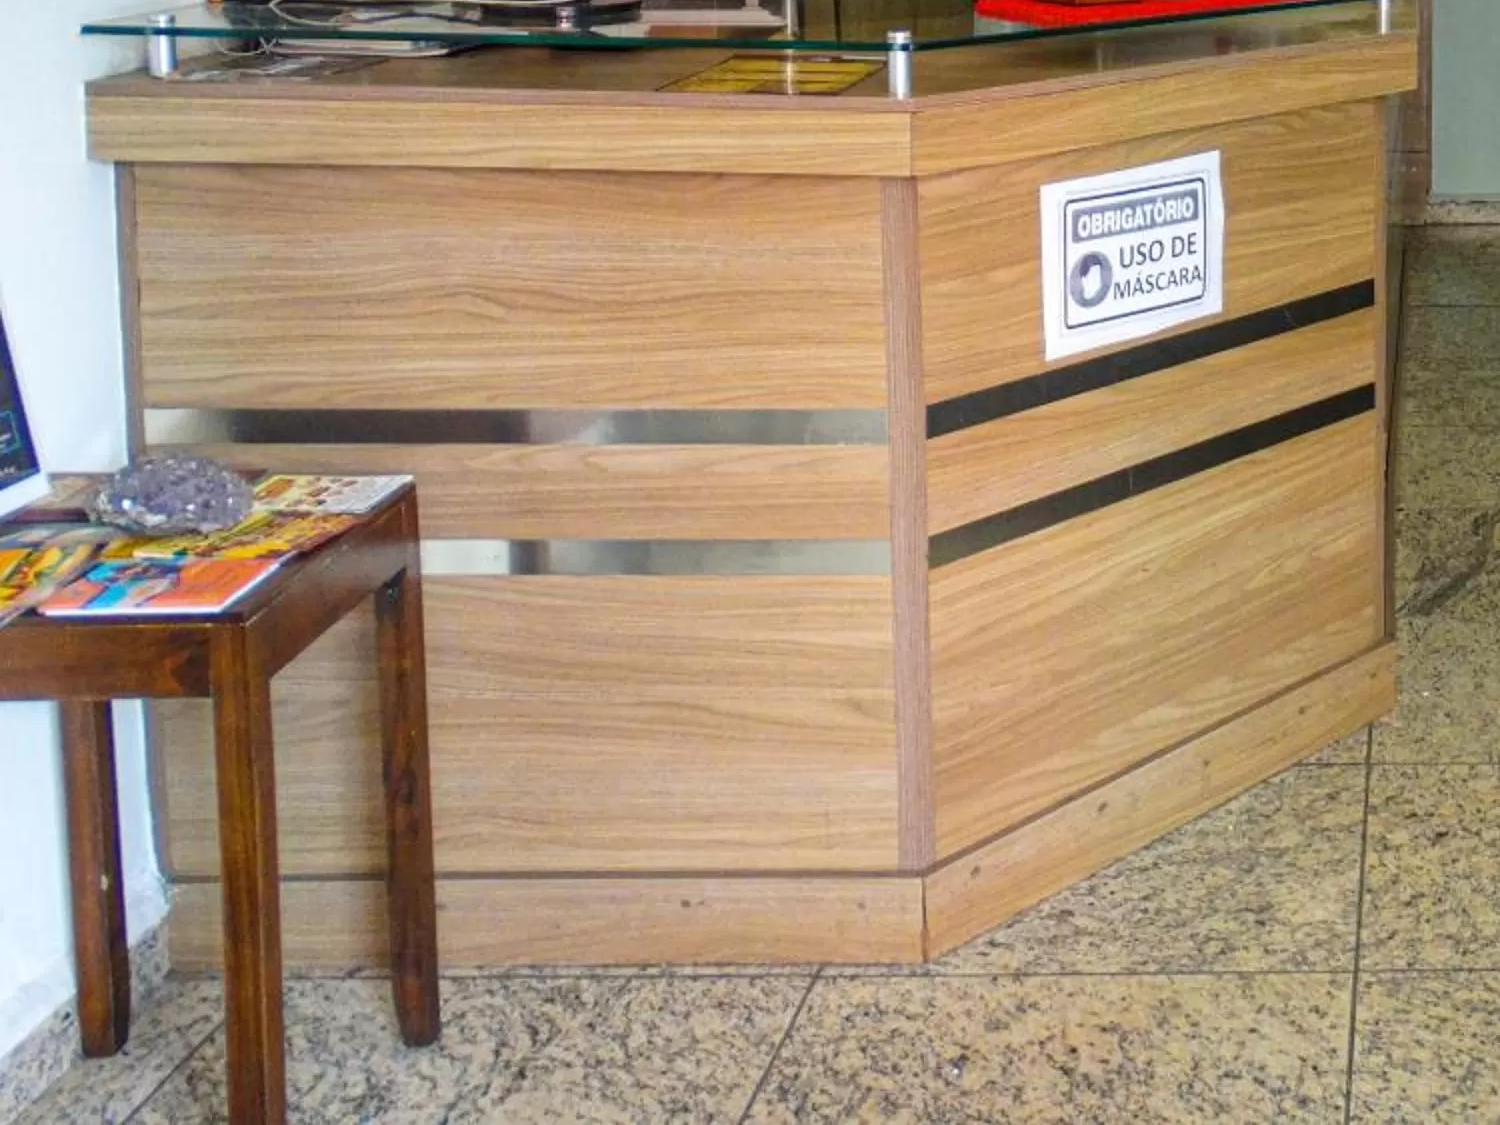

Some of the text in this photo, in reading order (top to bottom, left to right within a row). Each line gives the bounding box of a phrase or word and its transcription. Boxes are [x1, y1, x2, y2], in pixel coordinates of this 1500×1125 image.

[1077, 195, 1194, 238] OBRIGATÓRIO
[1119, 232, 1198, 269] USO DE
[1113, 265, 1203, 300] MÁSCARA
